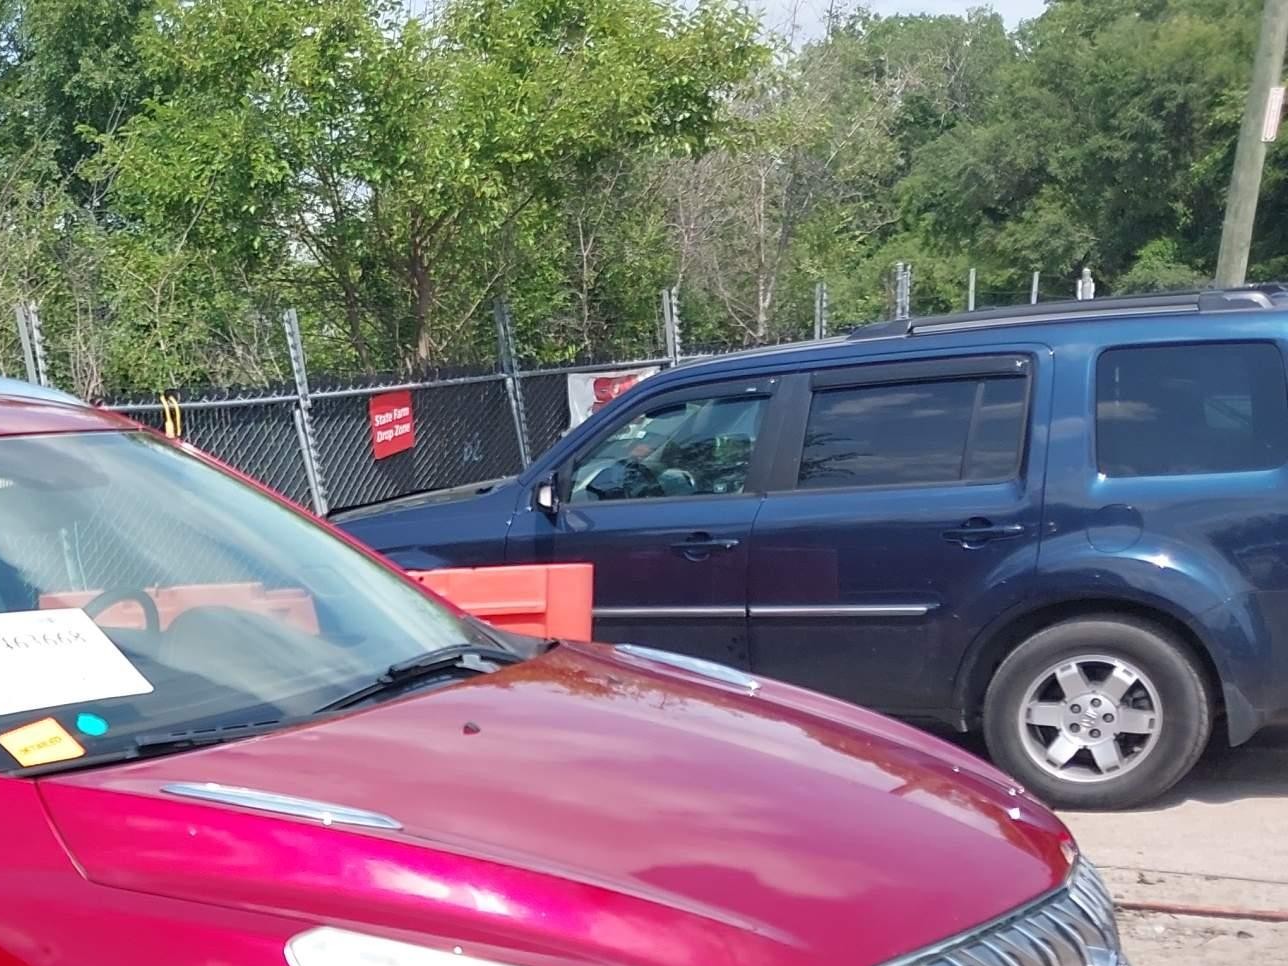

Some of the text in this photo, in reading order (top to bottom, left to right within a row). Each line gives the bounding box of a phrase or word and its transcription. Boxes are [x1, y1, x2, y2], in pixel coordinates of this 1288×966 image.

[375, 407, 410, 427] State Farm
[376, 423, 410, 443] Drop Zone
